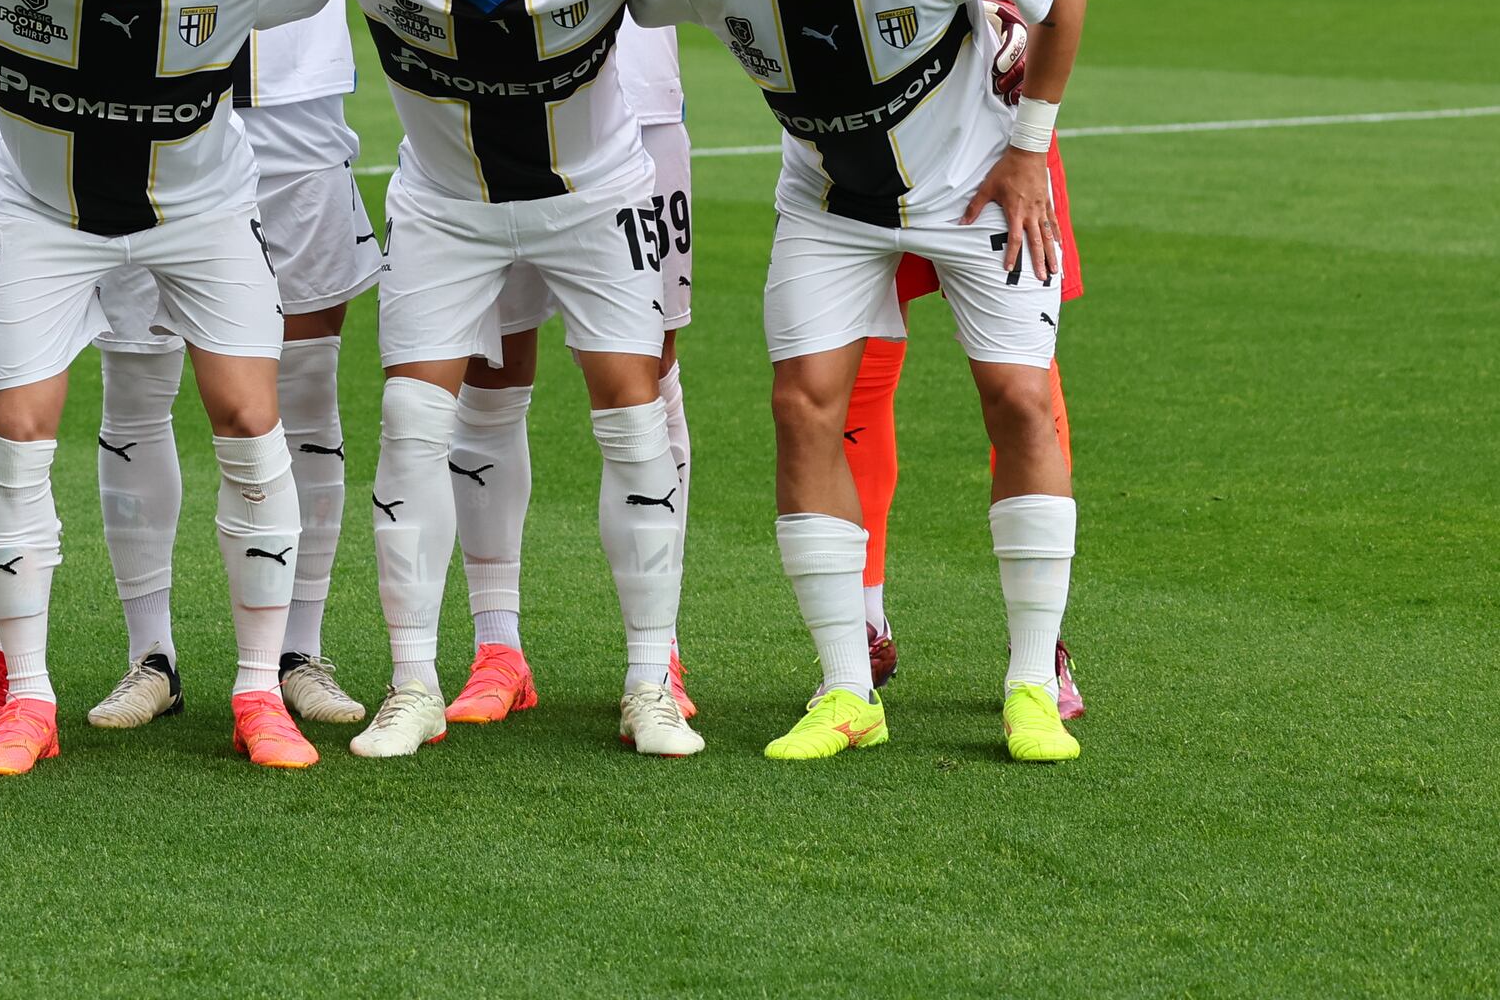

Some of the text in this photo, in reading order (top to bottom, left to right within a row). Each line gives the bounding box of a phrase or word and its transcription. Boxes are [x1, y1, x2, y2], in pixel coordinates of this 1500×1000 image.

[0, 7, 68, 39] FOOTBALL
[15, 5, 52, 23] CLASSIC
[14, 24, 50, 44] SHIRTS
[391, 37, 607, 97] PROMETEON
[616, 207, 661, 272] 15
